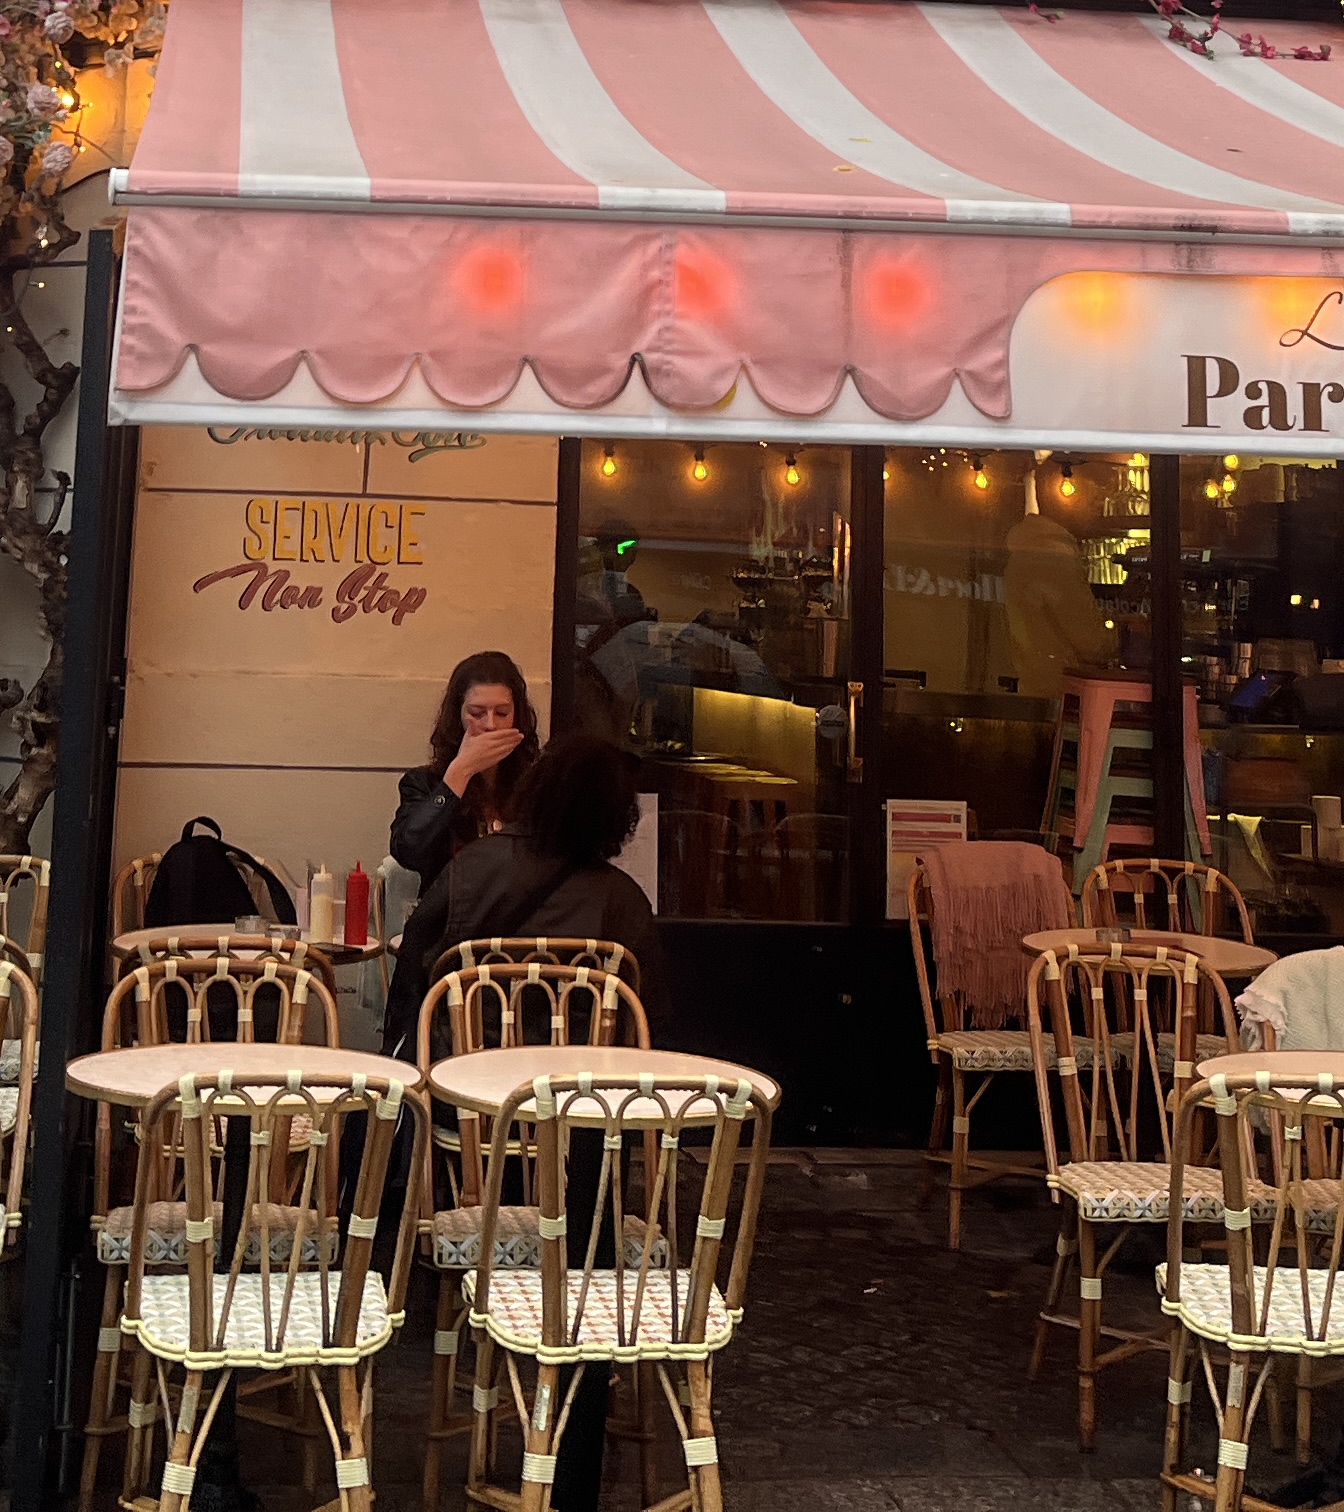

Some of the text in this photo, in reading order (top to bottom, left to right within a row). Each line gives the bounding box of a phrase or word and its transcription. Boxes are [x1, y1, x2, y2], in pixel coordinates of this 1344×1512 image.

[242, 498, 429, 566] SERVICE
[193, 561, 428, 626] Non Stop
